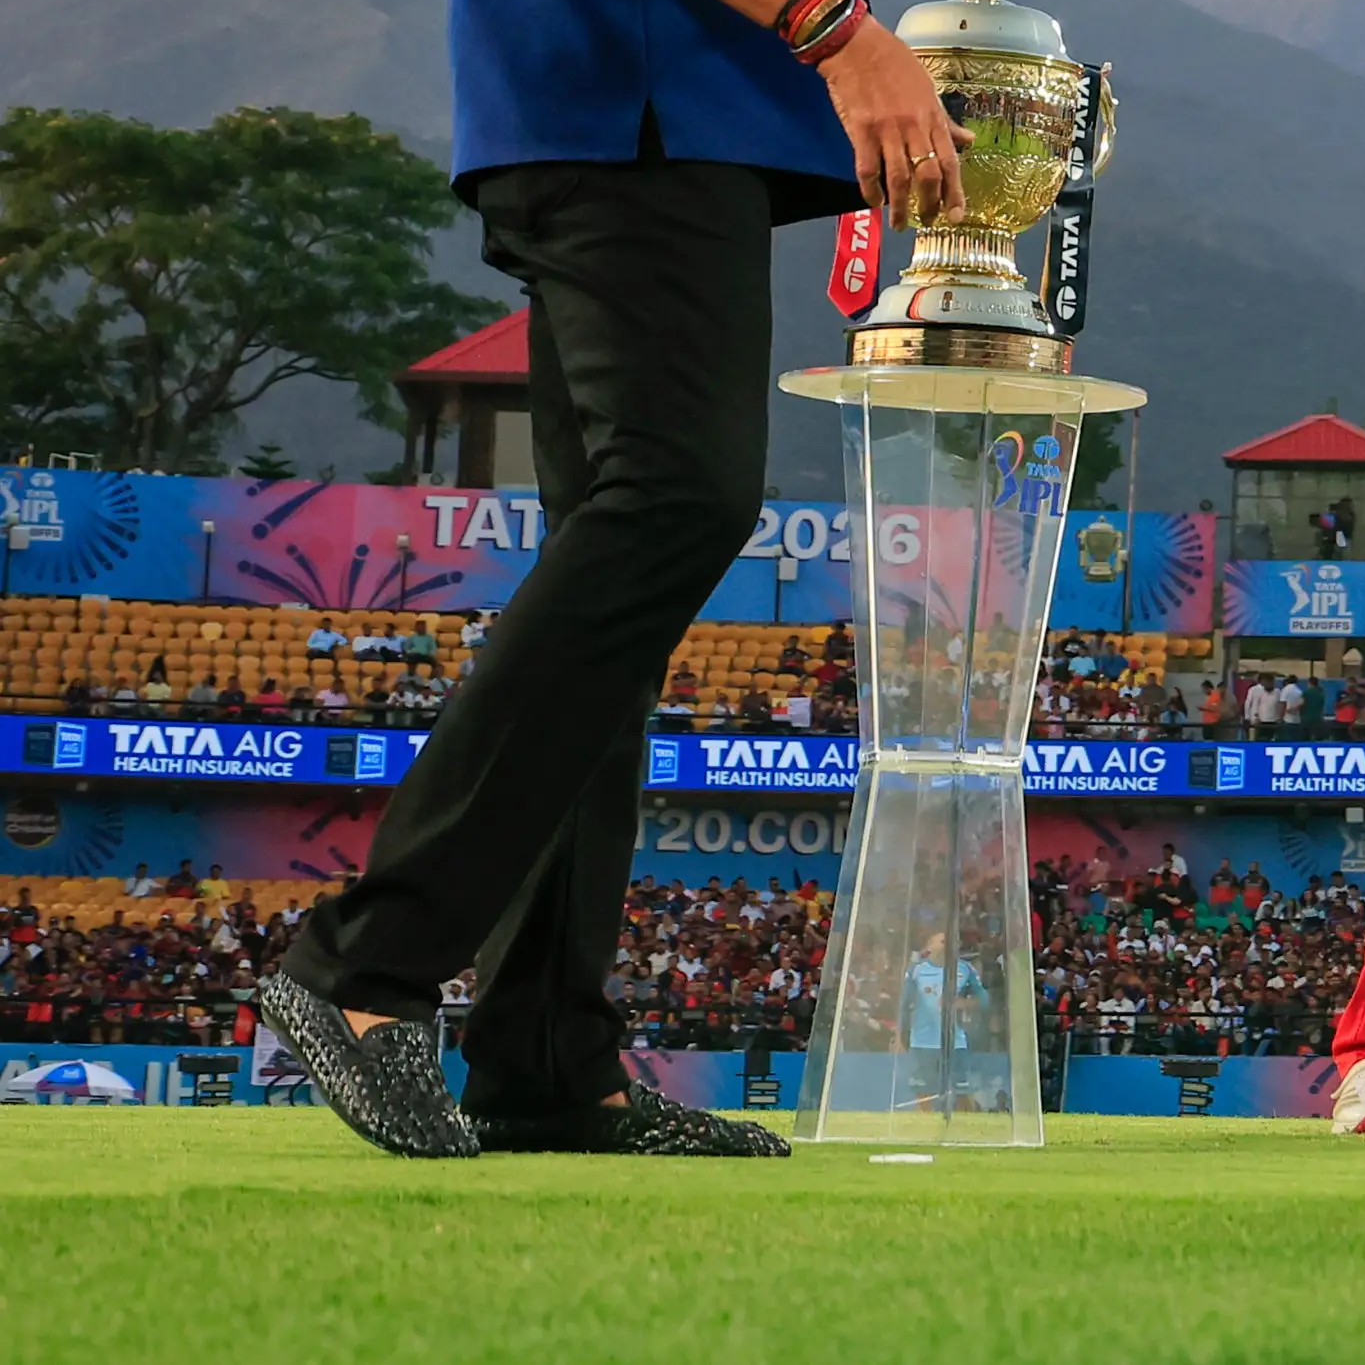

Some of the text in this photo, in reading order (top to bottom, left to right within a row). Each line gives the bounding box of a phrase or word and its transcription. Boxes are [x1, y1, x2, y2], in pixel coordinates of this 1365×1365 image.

[1071, 76, 1091, 141] TATA
[1060, 214, 1081, 282] TATA
[1019, 477, 1065, 518] IPL
[1311, 591, 1353, 616] IPL
[1291, 620, 1351, 631] PLAYOFFS
[108, 723, 303, 759] TATA AIG
[113, 756, 294, 778] HEALTH INSURANCE
[700, 739, 861, 771] TATA AI
[1101, 746, 1167, 774] AIG
[706, 770, 771, 787] HEALTH
[1058, 776, 1159, 792] INSURANCE
[1271, 777, 1334, 792] HEALTH
